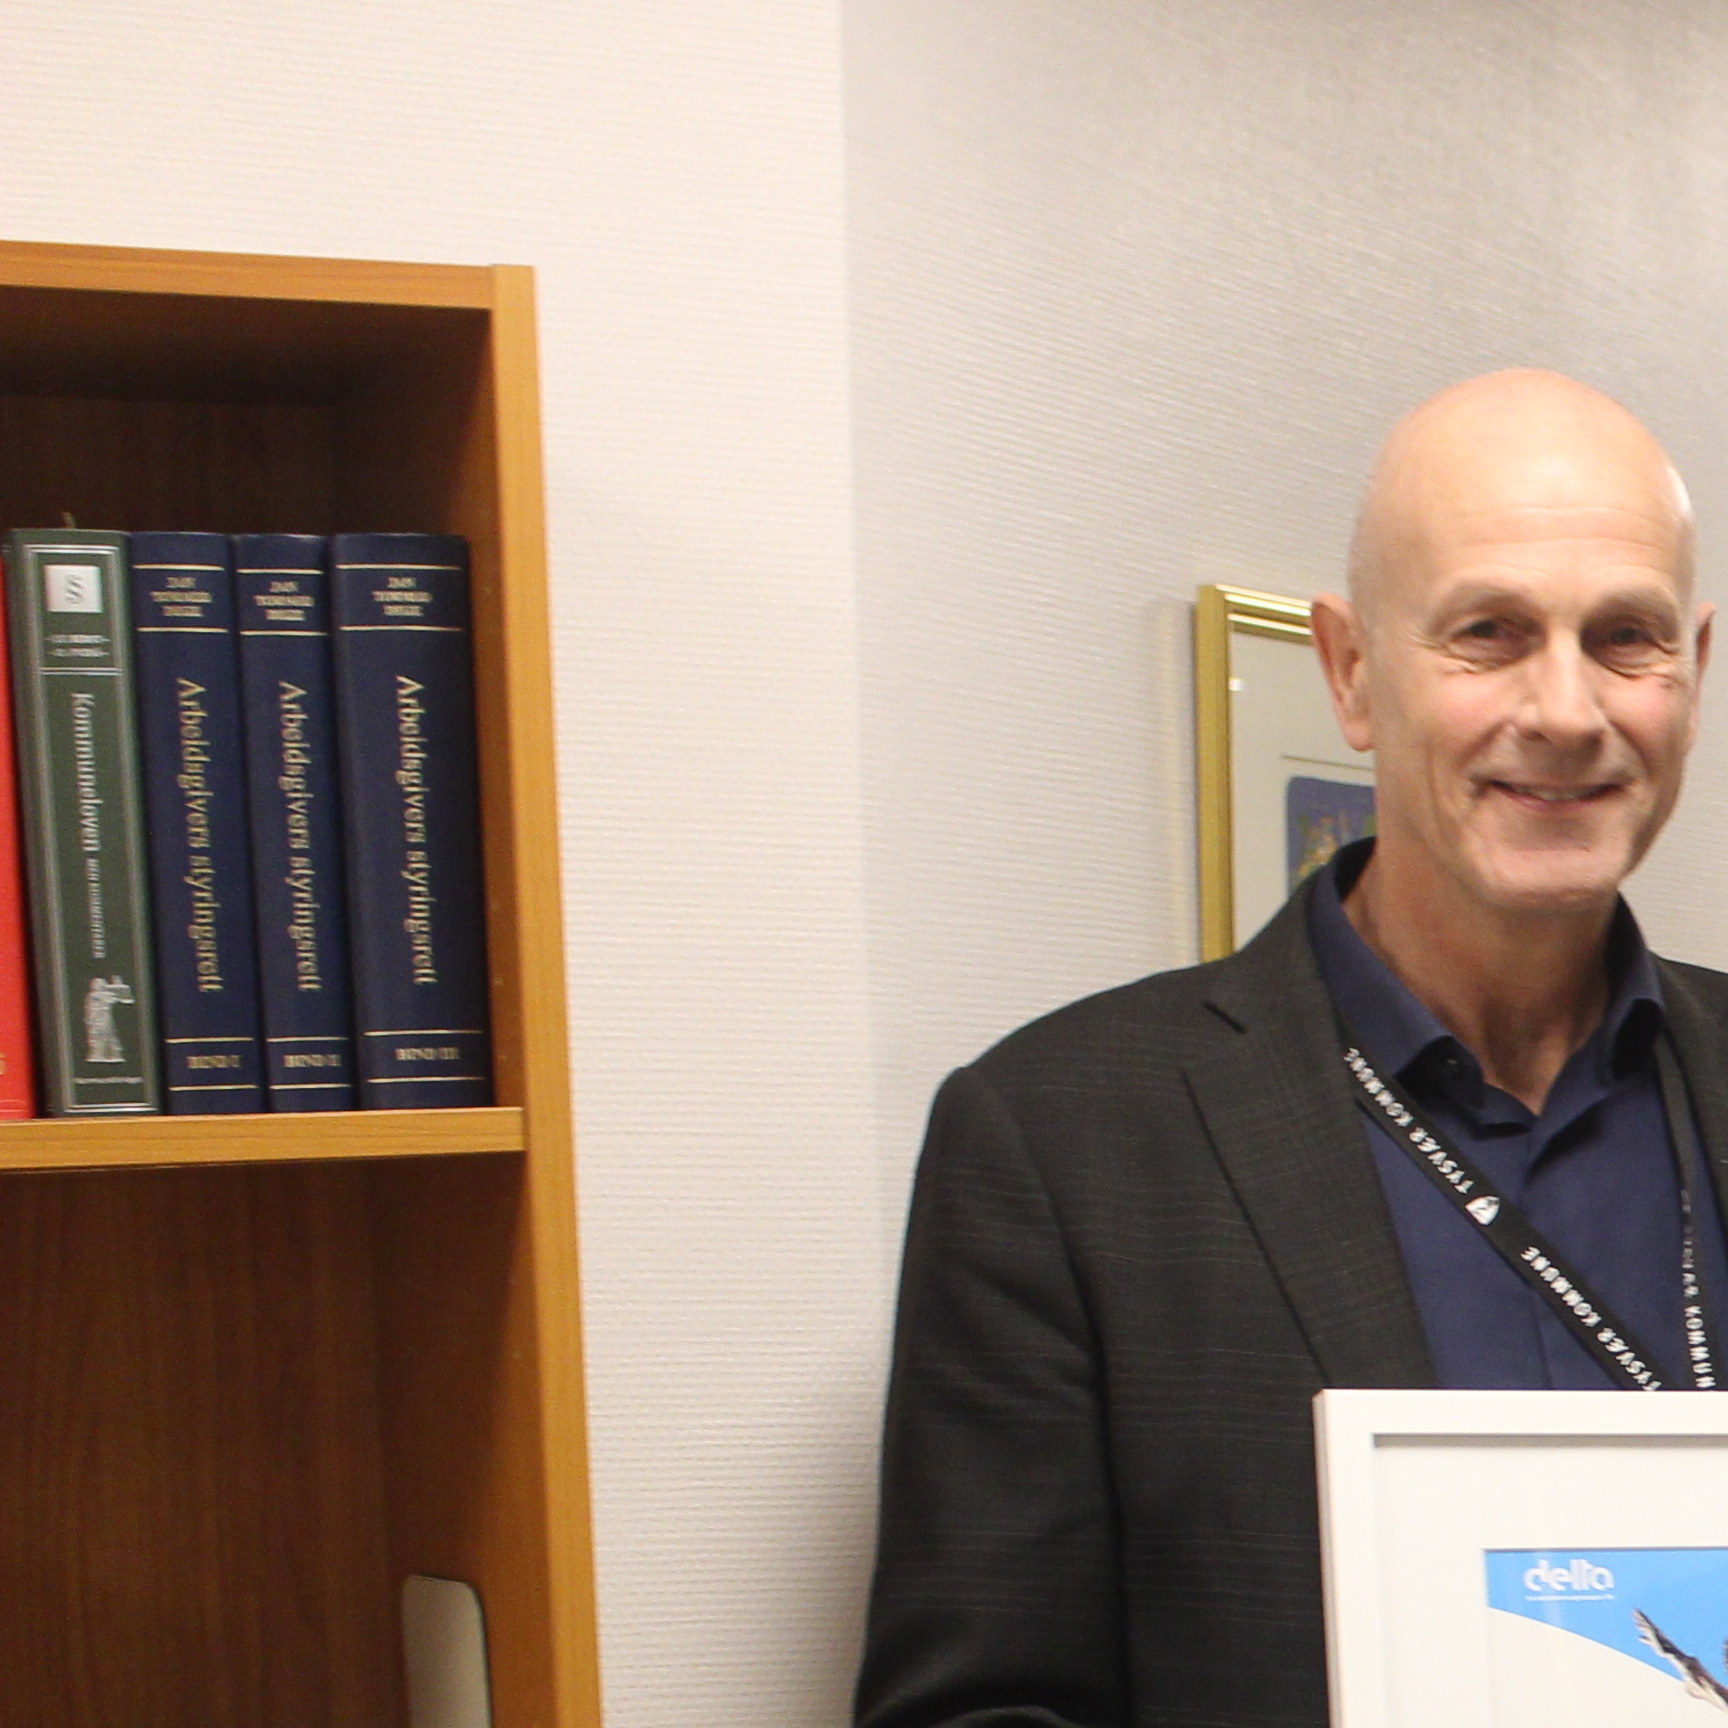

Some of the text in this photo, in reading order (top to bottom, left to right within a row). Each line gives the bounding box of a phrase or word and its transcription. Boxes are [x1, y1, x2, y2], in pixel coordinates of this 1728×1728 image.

[71, 692, 105, 852] Kommuneloven
[177, 677, 224, 993] Arbeidsgivers styringsrett
[279, 680, 323, 993] Arbeidsgivers styringsrett
[396, 674, 438, 985] Arbeidsgivers styringsrett
[1409, 1127, 1474, 1194] TYSVÆR
[1520, 1246, 1662, 1392] TYSVÆR KOMMUNE
[1684, 1305, 1716, 1389] KOMMUN
[1522, 1557, 1615, 1592] delta
